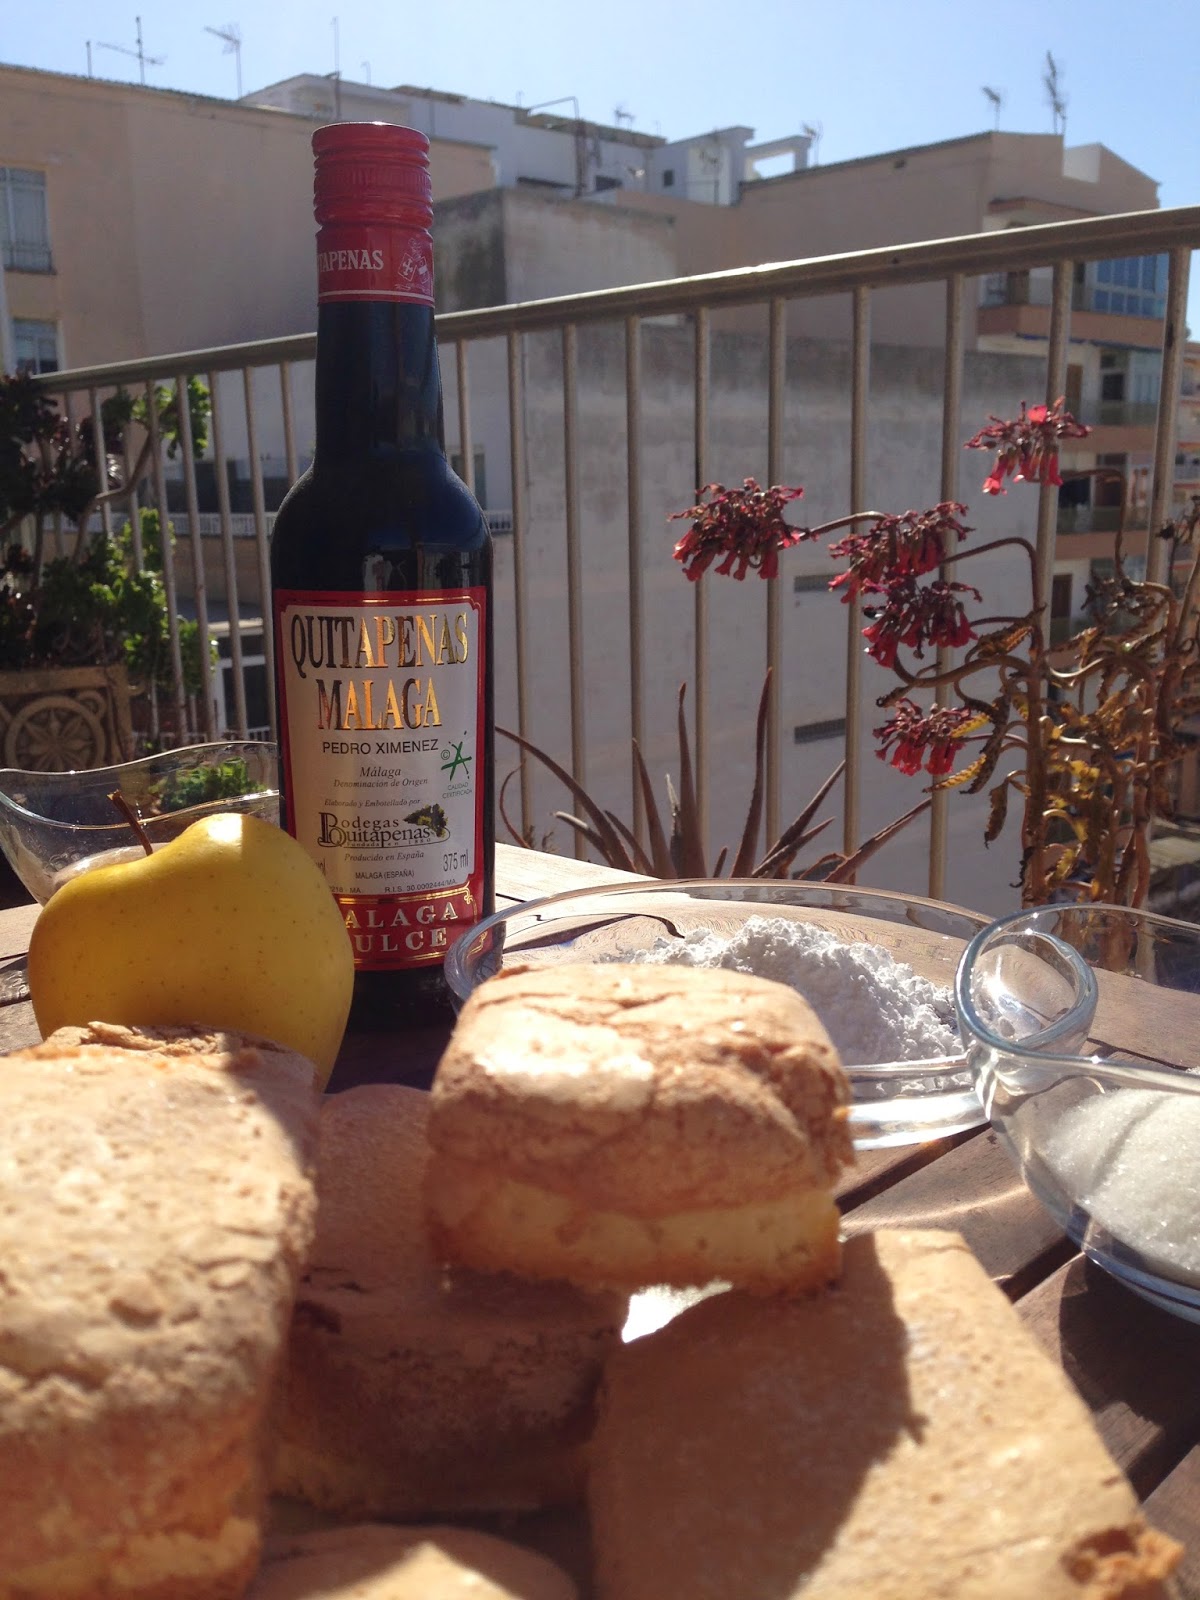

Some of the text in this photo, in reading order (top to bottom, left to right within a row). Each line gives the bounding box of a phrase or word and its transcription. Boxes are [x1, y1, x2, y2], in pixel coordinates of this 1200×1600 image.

[291, 612, 469, 679] QUITAPENAS
[316, 677, 442, 731] MALAGA
[322, 738, 439, 755] PEDRO XIMENEZ
[360, 766, 402, 779] Málaga
[390, 778, 400, 787] de
[402, 778, 428, 788] Origen
[447, 782, 469, 791] CALIDAD
[324, 798, 421, 808] Elaborado y Embotellado por
[318, 812, 399, 843] Bodegas
[328, 826, 431, 848] Quitapenas
[344, 853, 384, 862] Producido
[397, 851, 424, 862] España
[443, 849, 469, 872] 375 ml
[384, 868, 415, 879] (ESPAÑA)
